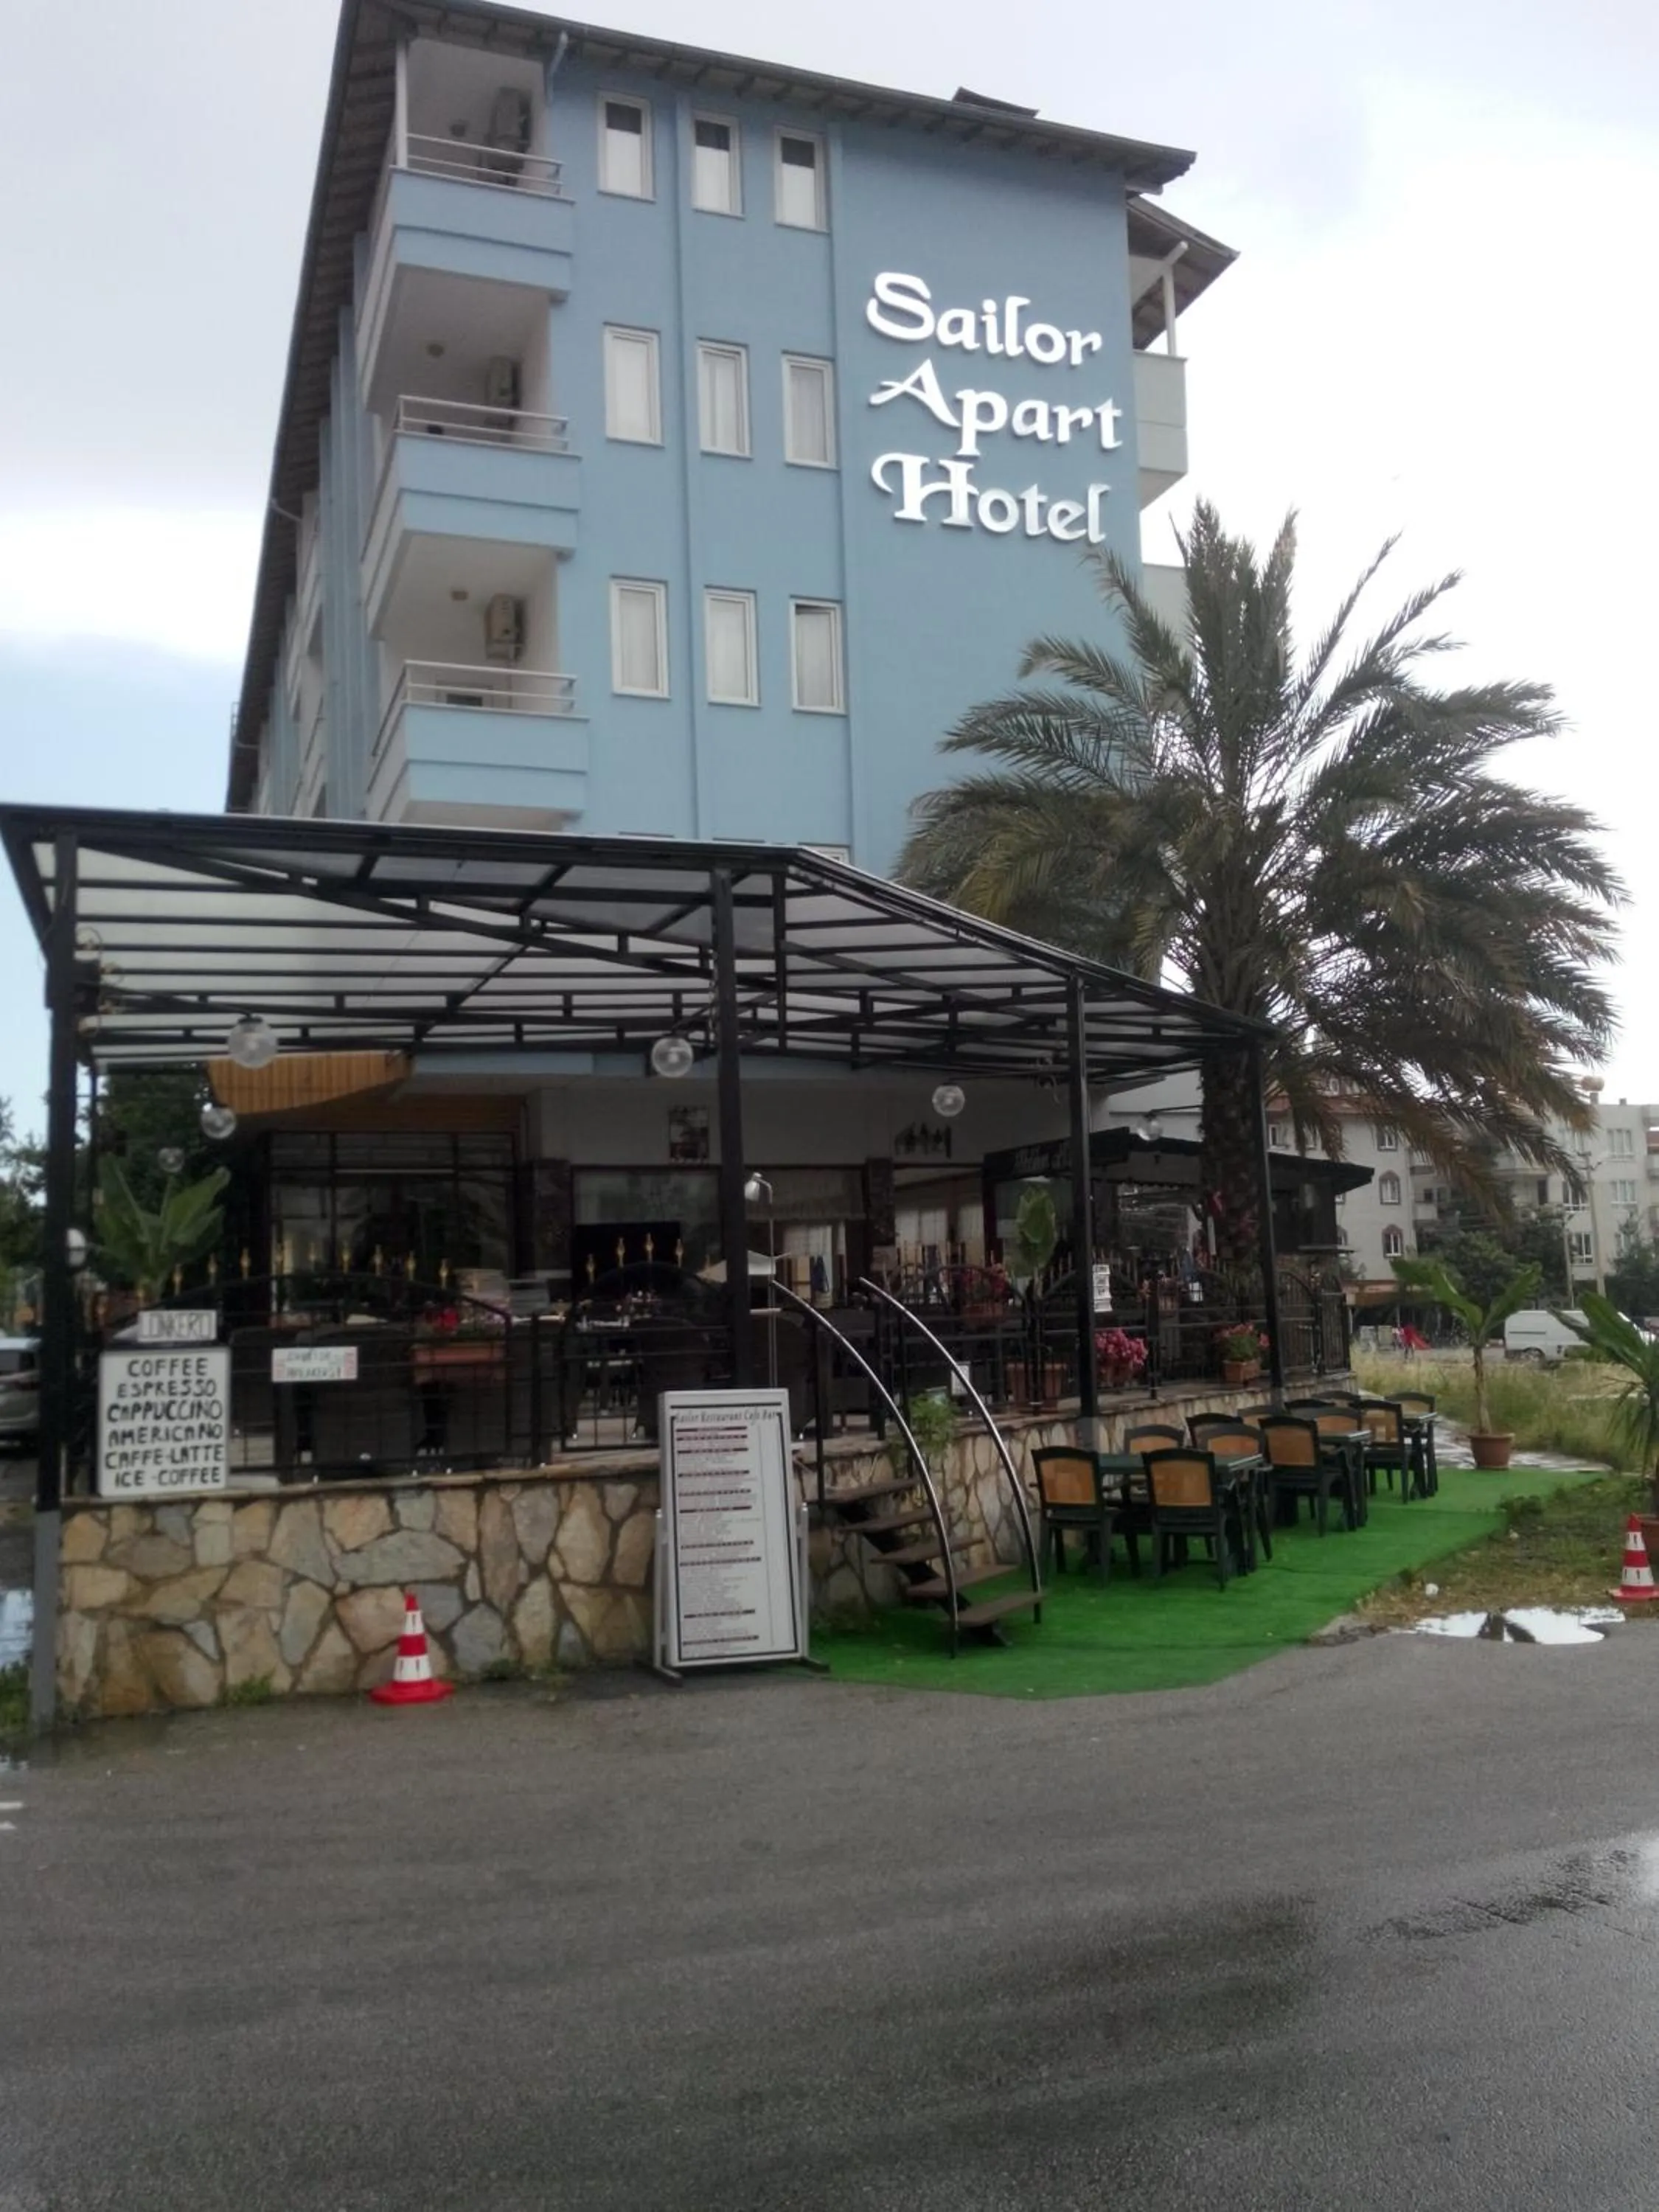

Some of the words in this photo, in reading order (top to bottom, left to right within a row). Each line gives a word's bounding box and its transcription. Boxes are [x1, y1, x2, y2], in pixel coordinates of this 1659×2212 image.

[866, 271, 1102, 365] Sailor
[869, 358, 1123, 456] Apart
[871, 452, 1110, 543] Hotel
[128, 1357, 208, 1377] COFFEE
[117, 1380, 217, 1399] ESPRESSO
[107, 1399, 222, 1423] CAPPUCCINO
[700, 1411, 742, 1423] Restaurant
[108, 1423, 223, 1447] AMERICANO
[115, 1471, 145, 1487] ICE
